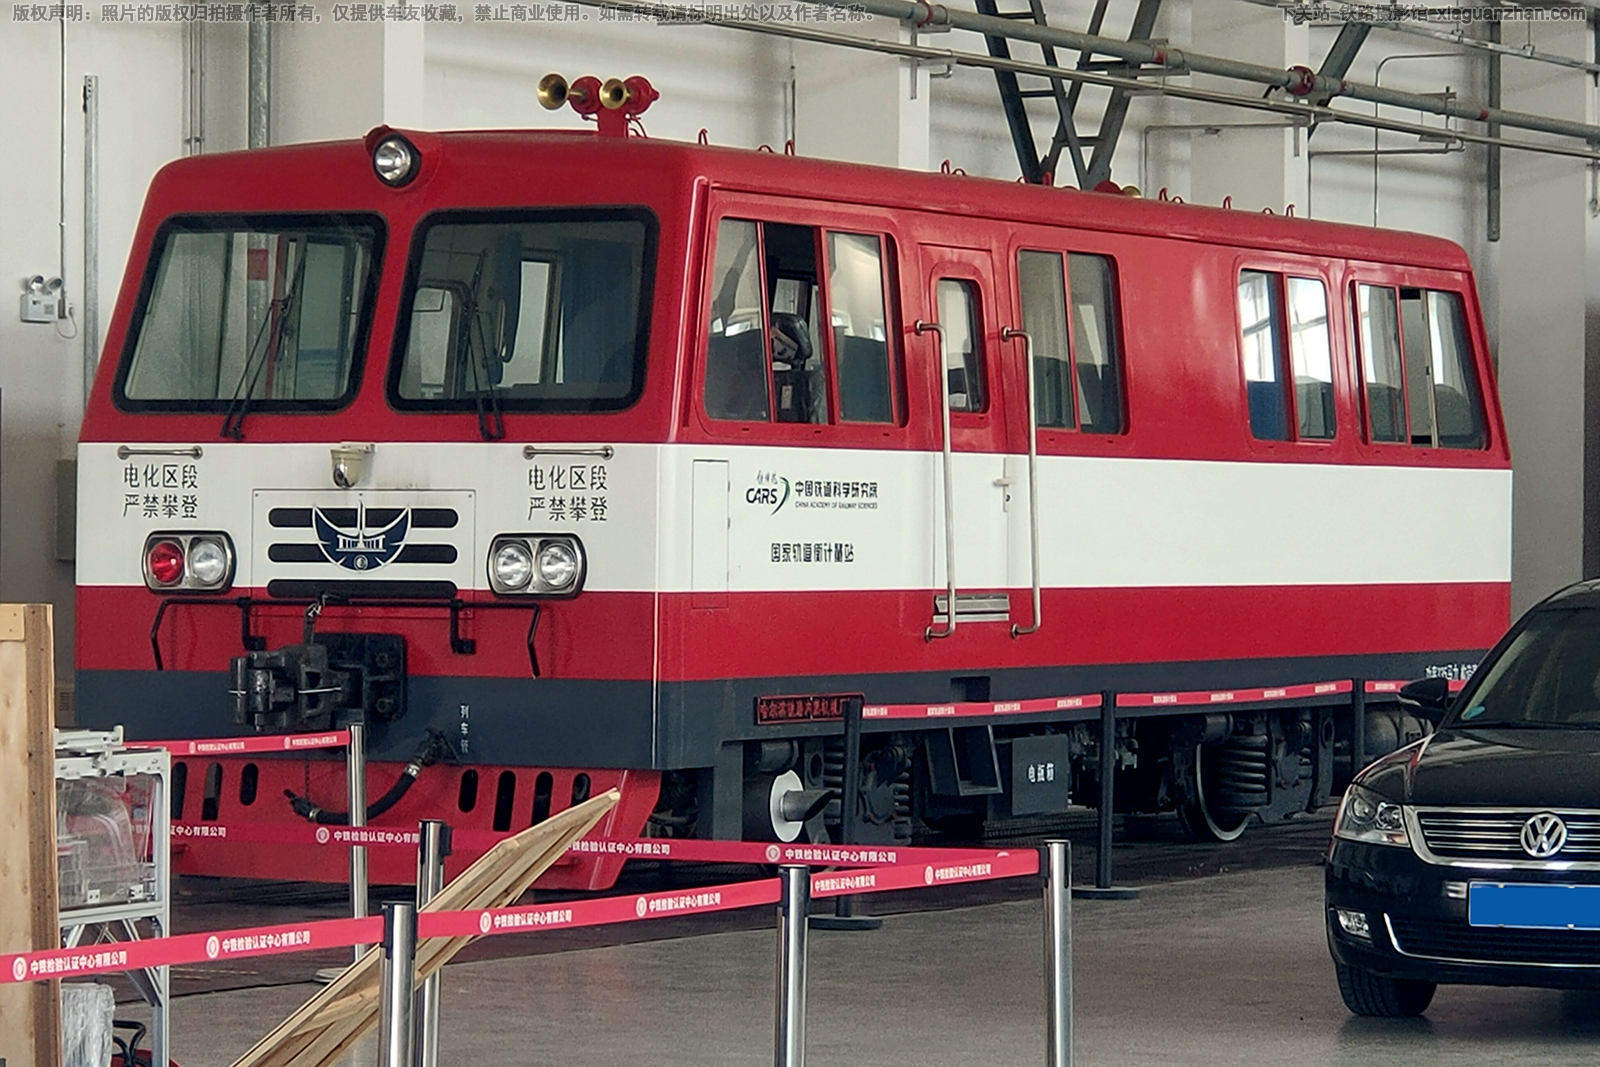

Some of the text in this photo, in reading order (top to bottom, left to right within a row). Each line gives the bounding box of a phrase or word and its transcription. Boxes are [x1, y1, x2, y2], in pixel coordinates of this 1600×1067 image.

[125, 463, 198, 489] 电化区段
[529, 464, 607, 490] 电化区段
[746, 488, 778, 505] CARS
[795, 481, 878, 498] 中国铁道科学研究院
[123, 494, 198, 518] 严禁攀登
[528, 496, 607, 521] 严禁攀登
[771, 543, 854, 562] 国家轨道衡计量站
[785, 849, 897, 863] 中铁检验认证中心有限公司
[222, 930, 310, 953] 中铁检验认证中心有限公司
[30, 950, 127, 975] 中铁检验认证中心有限公司
